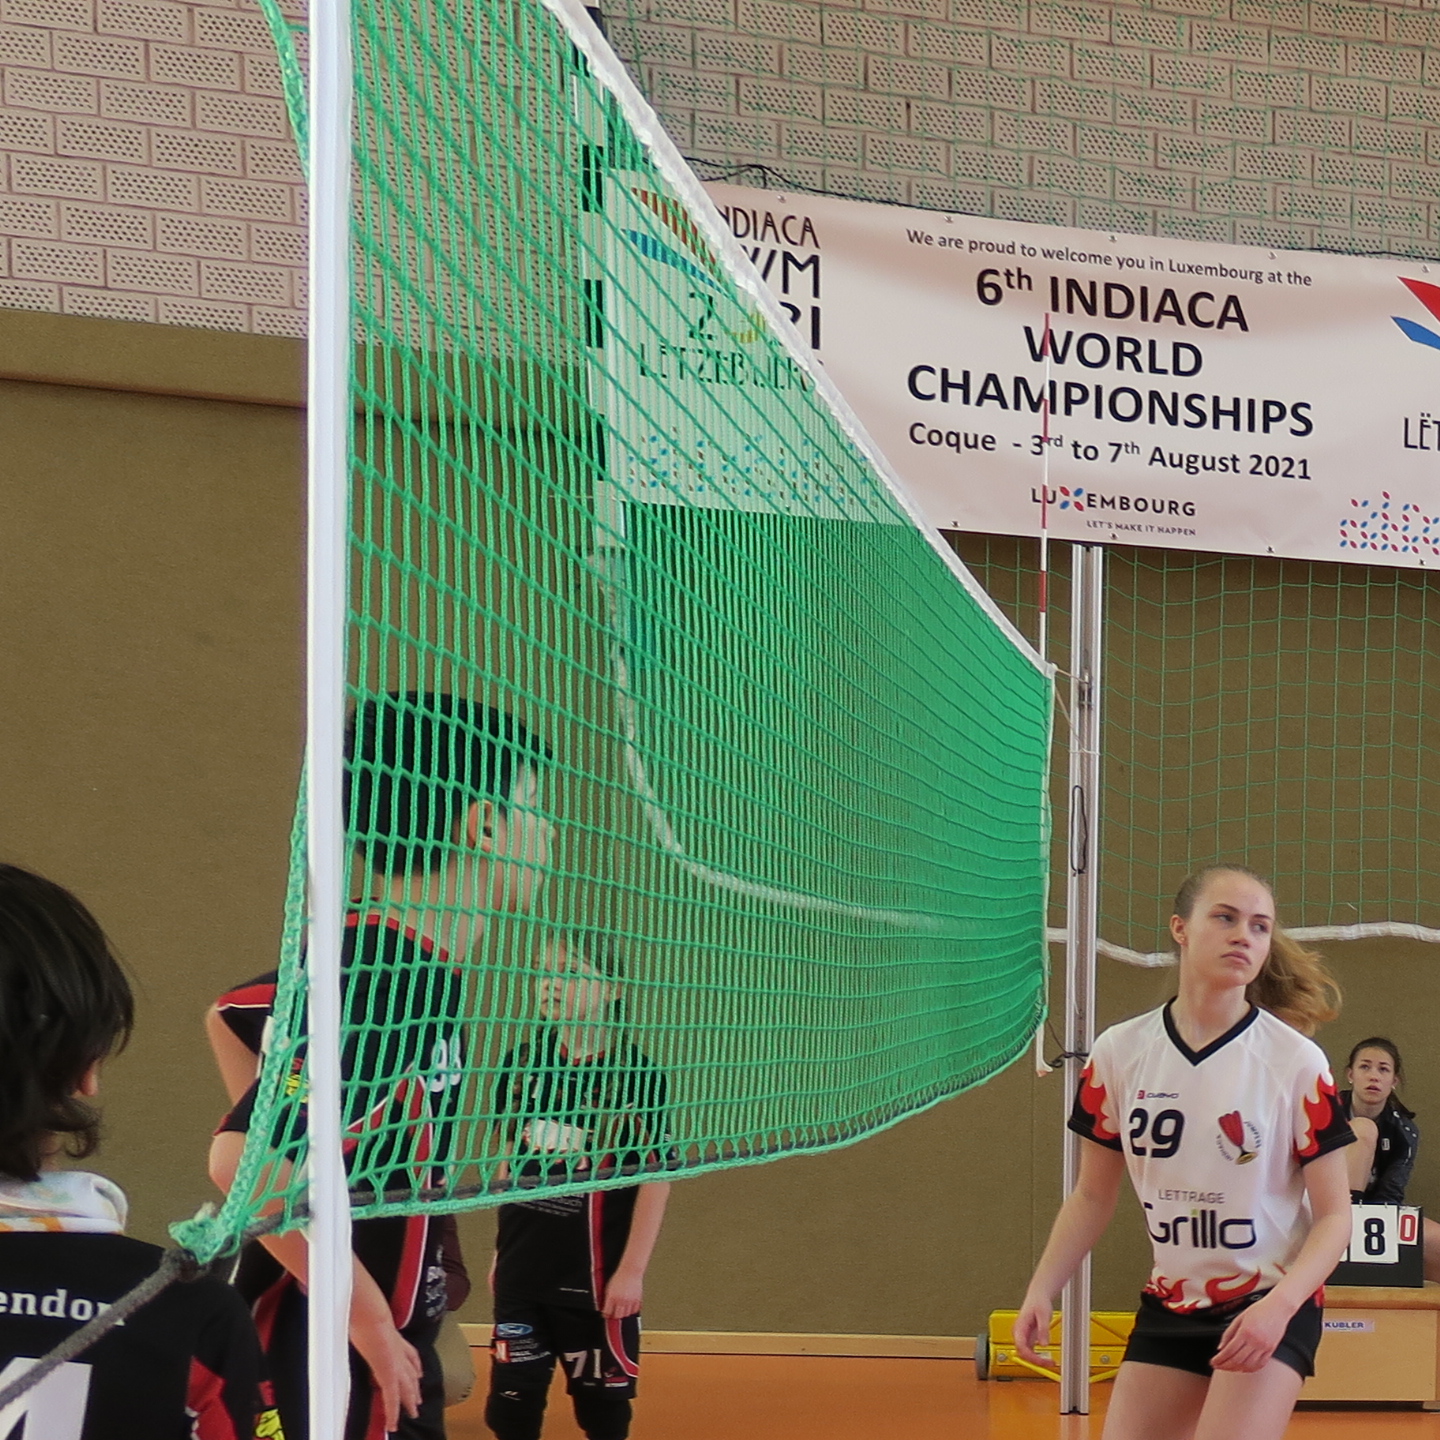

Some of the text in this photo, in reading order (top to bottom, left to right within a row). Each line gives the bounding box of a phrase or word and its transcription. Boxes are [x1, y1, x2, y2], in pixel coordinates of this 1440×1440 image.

[906, 228, 1313, 287] We are proud to welcome you in Luxembourg at the
[976, 266, 1249, 332] 6th INDIACA
[1022, 325, 1204, 378] WORLD
[906, 363, 1314, 438] CHAMPIONSHIPS
[908, 421, 997, 454] Coque
[1030, 433, 1063, 456] 3rd
[1071, 440, 1100, 461] to
[1107, 440, 1141, 463] 7th
[1148, 446, 1241, 475] August
[1248, 453, 1312, 481] 2021
[1086, 520, 1197, 536] LET'S MAKE IT HAPPEN
[1129, 1107, 1186, 1159] 29
[1158, 1188, 1225, 1204] LETTRAGE
[1364, 1214, 1416, 1256] 8 0
[563, 1349, 602, 1379] 71
